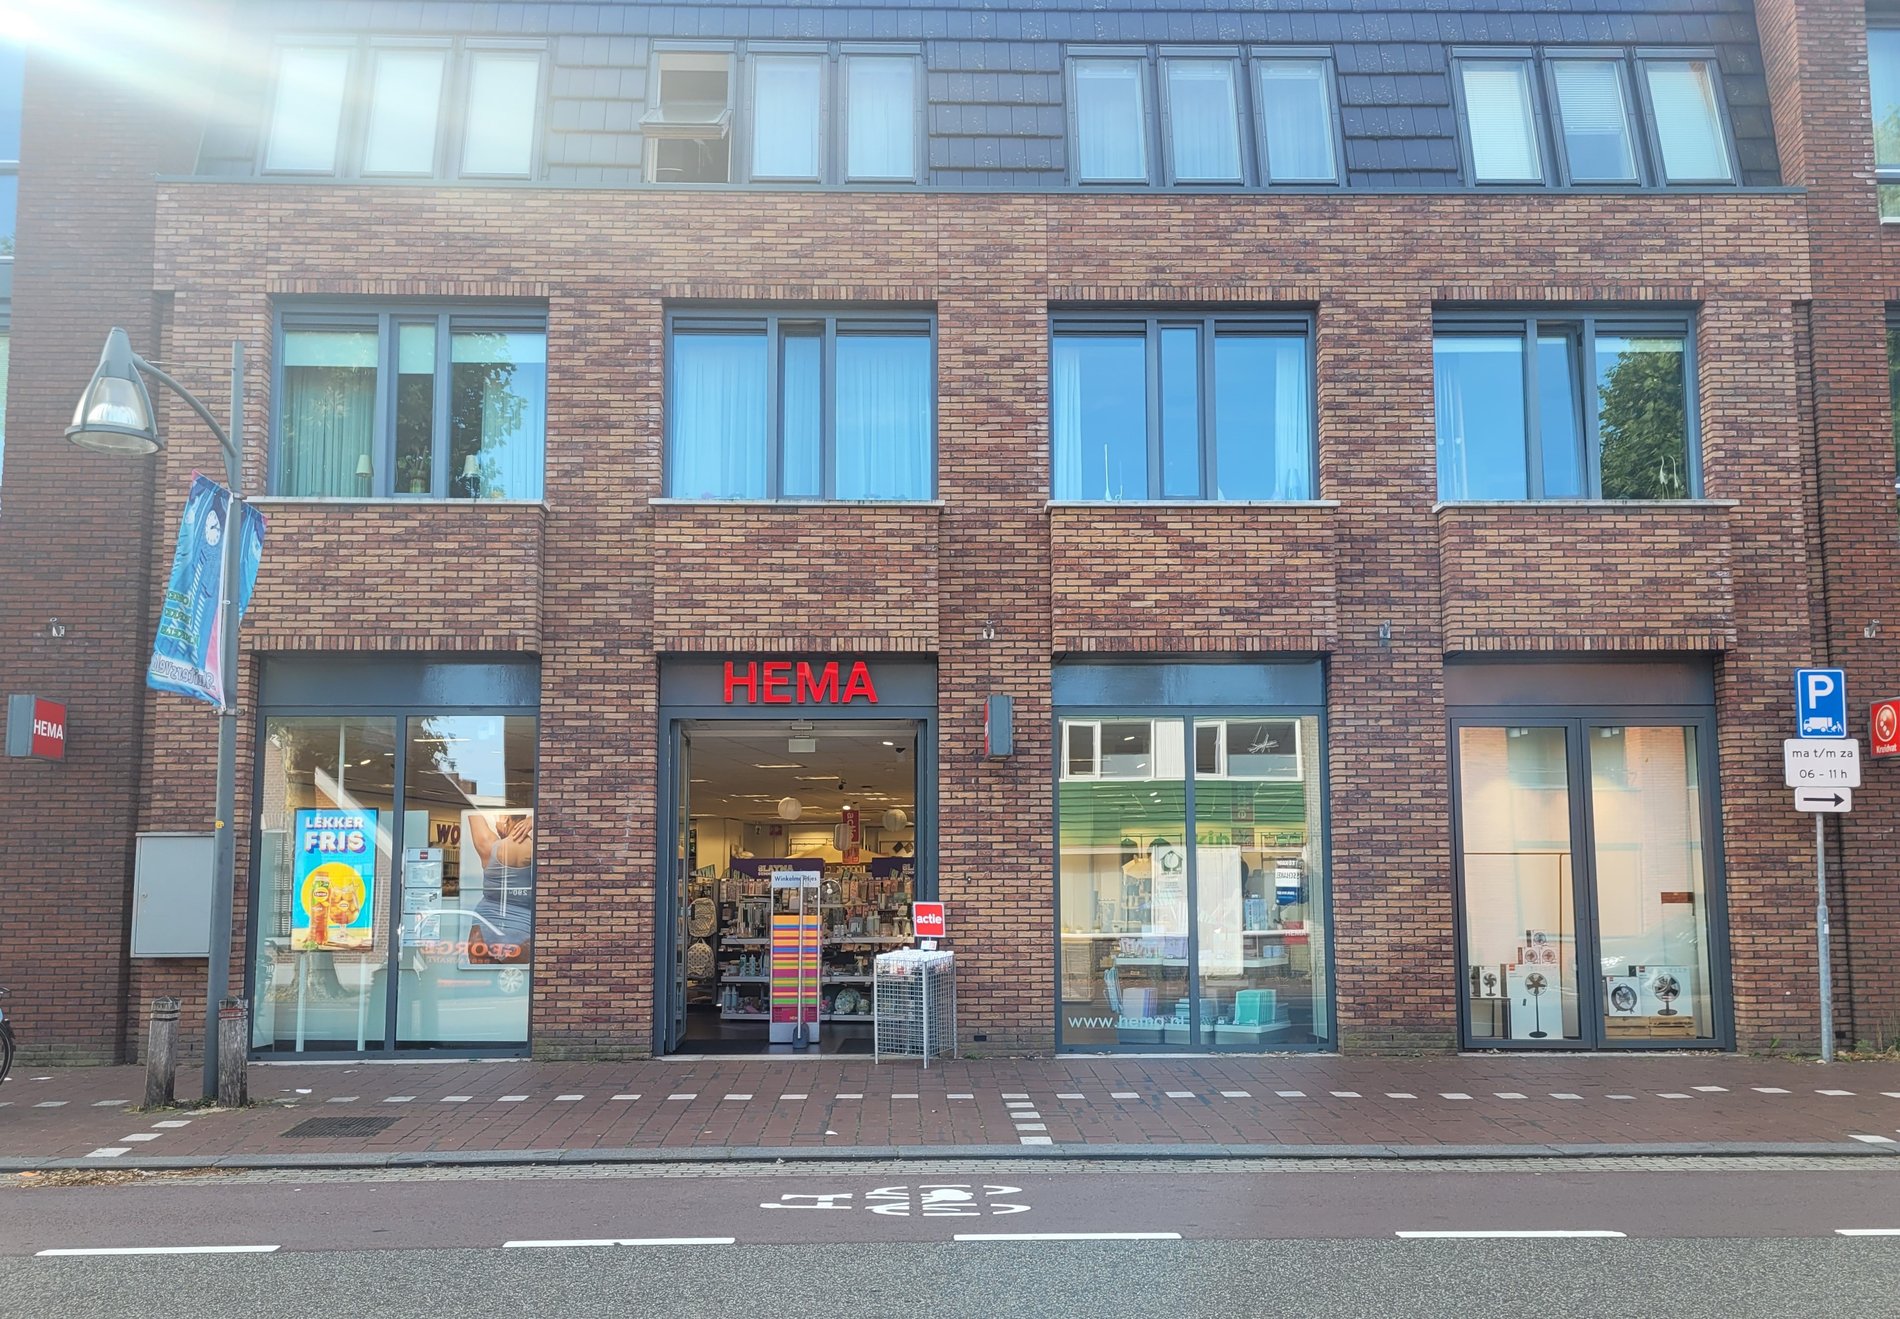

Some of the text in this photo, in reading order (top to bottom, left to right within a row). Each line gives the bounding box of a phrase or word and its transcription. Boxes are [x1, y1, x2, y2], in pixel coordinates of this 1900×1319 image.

[724, 661, 879, 704] HEMA
[1807, 675, 1834, 709] P
[33, 718, 63, 740] HEMA
[1792, 748, 1853, 758] ma t/m za
[1799, 769, 1815, 779] 06
[1828, 769, 1837, 779] 11
[1841, 769, 1848, 779] h
[305, 816, 363, 829] LEKKER
[304, 831, 366, 854] FRIS
[916, 913, 942, 925] actie
[1068, 1014, 1185, 1028] www.hema.nl
